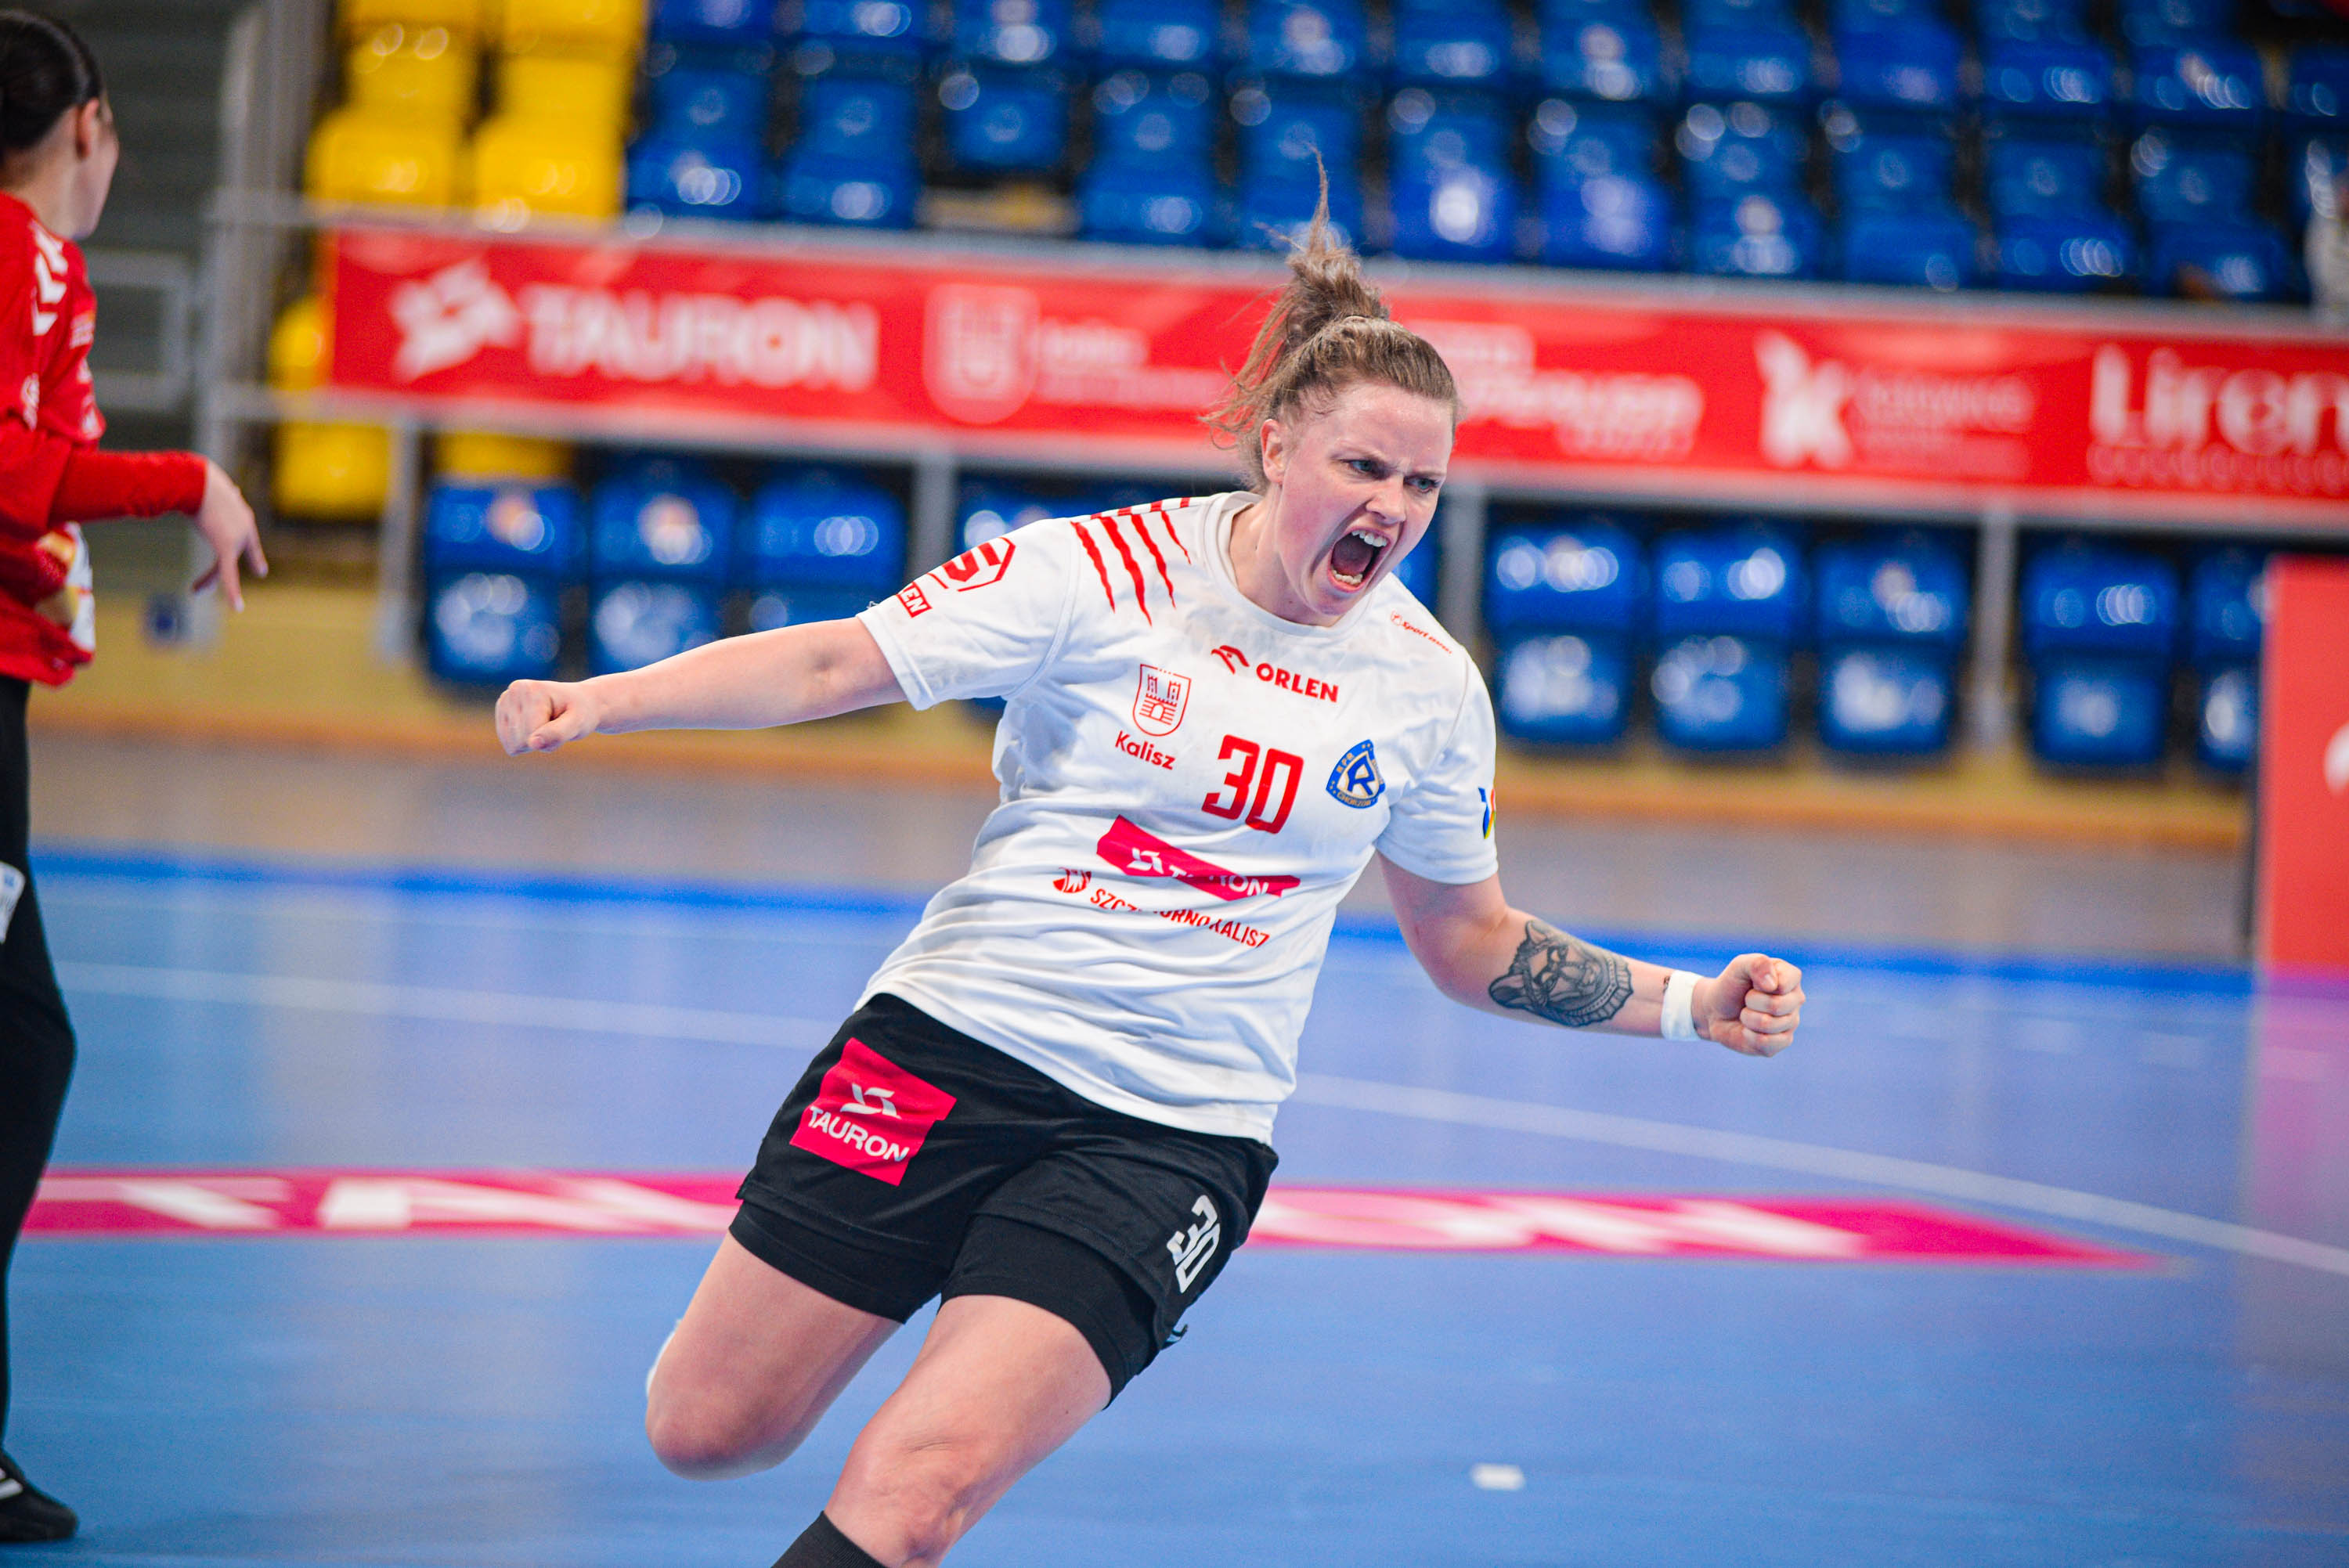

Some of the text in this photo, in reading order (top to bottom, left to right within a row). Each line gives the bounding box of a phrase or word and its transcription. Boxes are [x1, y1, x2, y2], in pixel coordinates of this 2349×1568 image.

[521, 282, 879, 388] TAURON
[1256, 662, 1339, 703] ORLEN
[1115, 730, 1176, 770] Kalisz
[1201, 734, 1304, 834] 30
[807, 1105, 910, 1162] TAURON
[1167, 1195, 1221, 1293] 30
